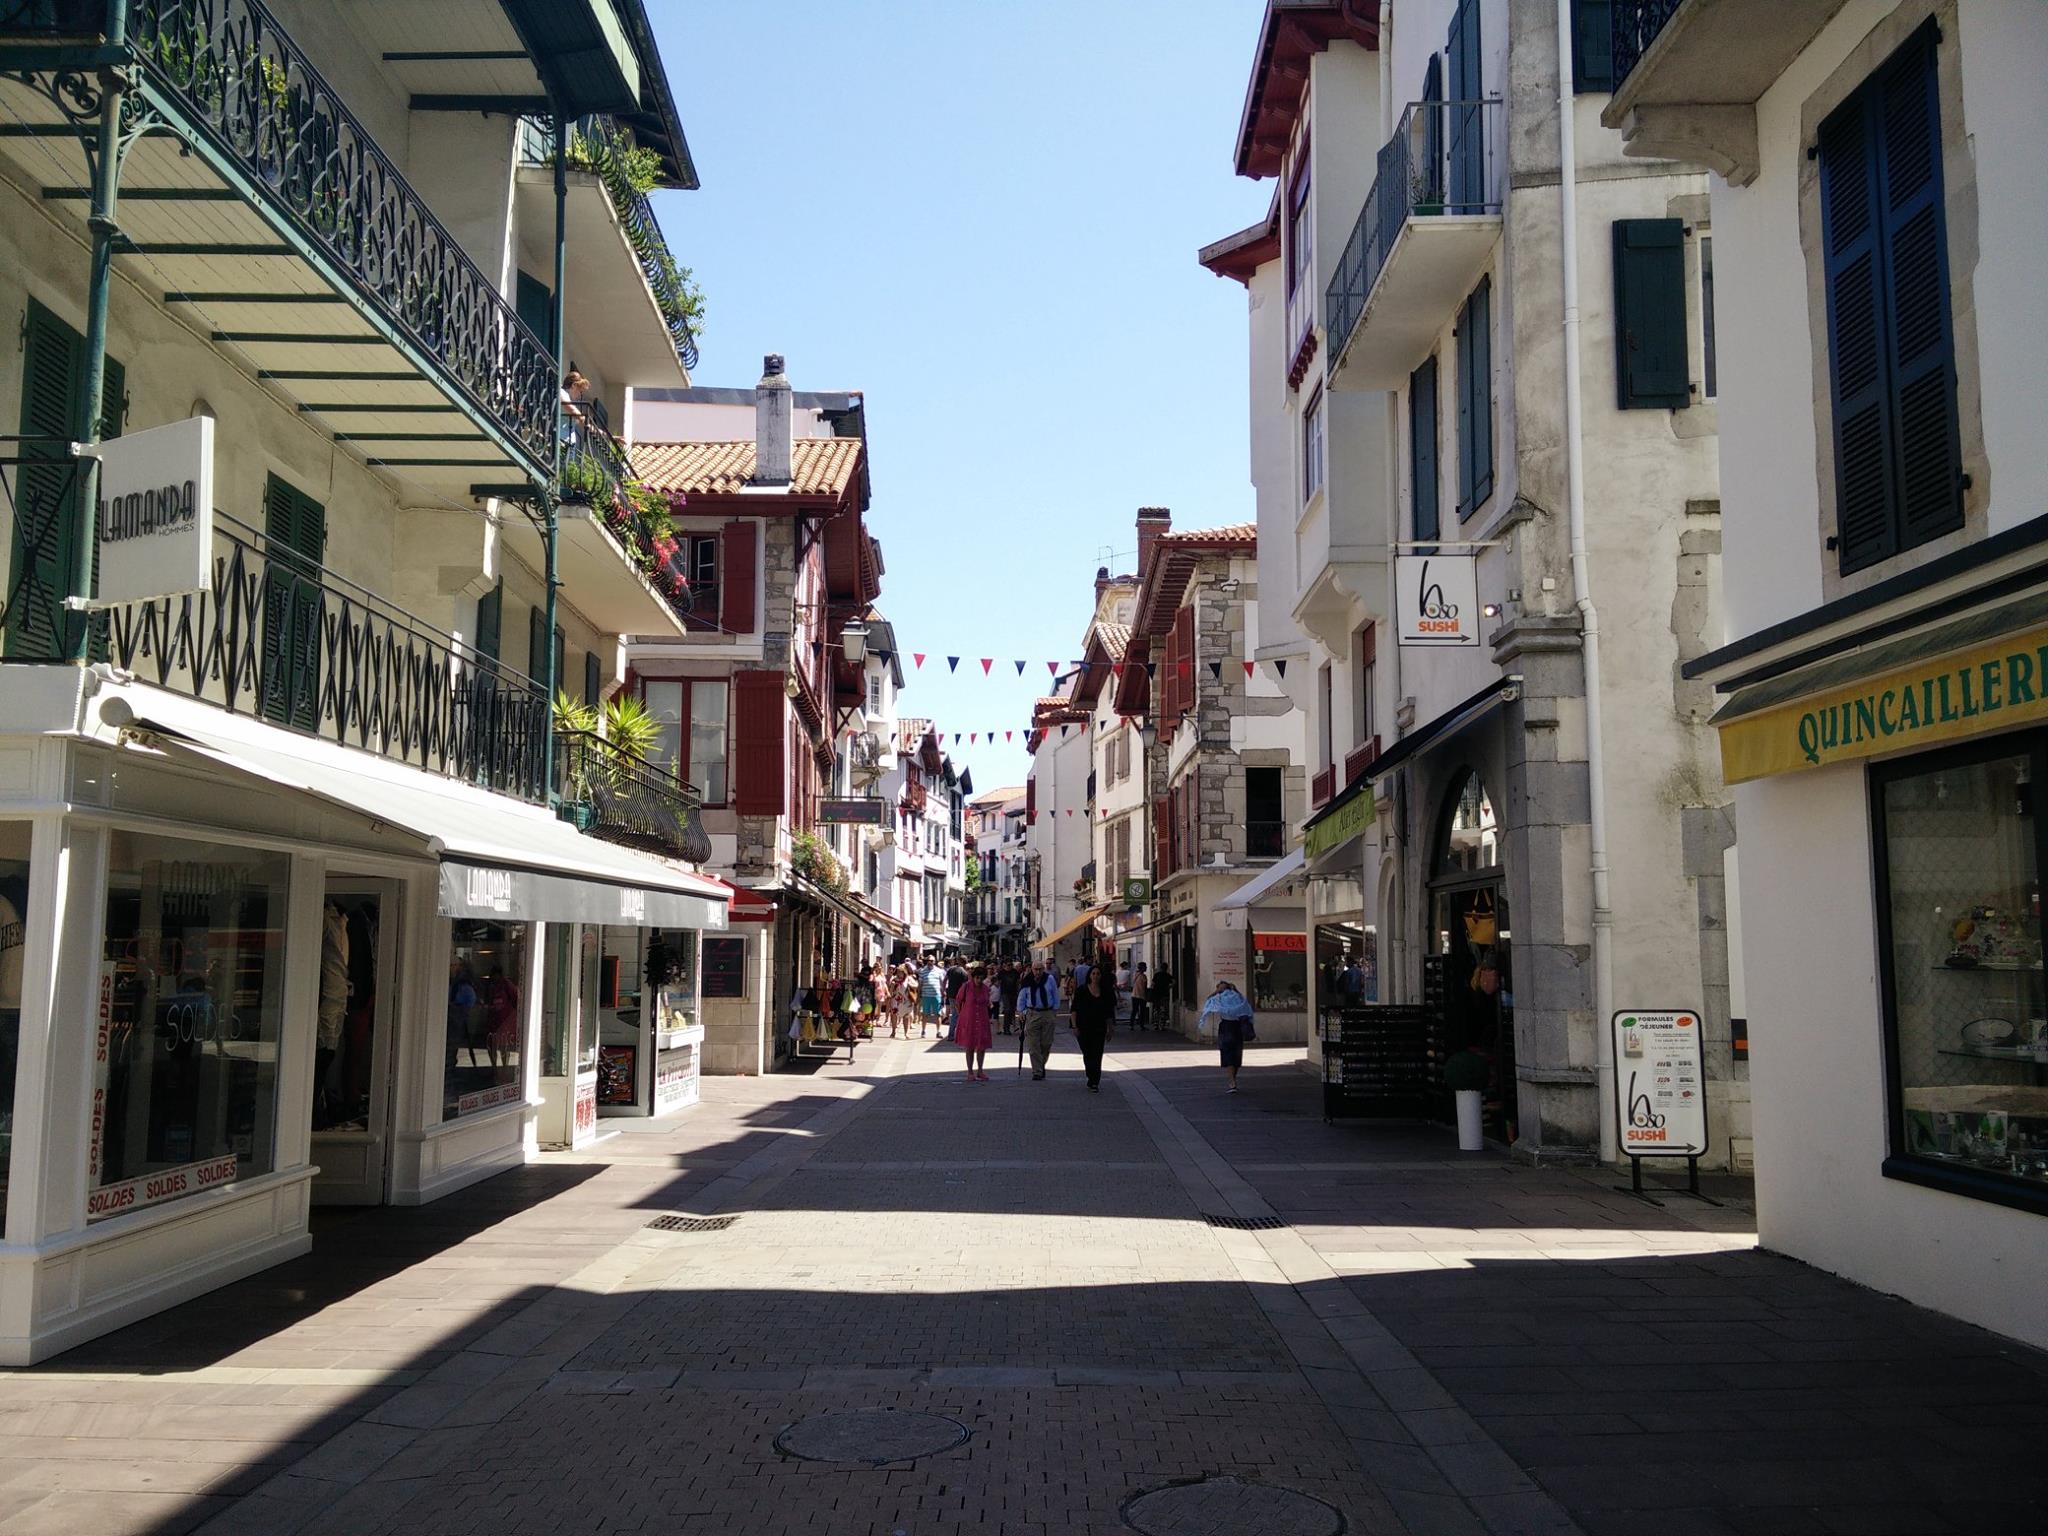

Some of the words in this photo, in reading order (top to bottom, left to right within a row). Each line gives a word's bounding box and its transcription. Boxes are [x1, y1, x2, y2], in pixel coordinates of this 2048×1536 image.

[101, 480, 196, 542] LAMANDA
[158, 523, 195, 537] HOMMES
[97, 974, 111, 1063] SOLDES
[89, 1087, 104, 1176] SOLDES
[88, 1187, 135, 1215] SOLDES
[146, 1174, 187, 1200] SOLDES
[197, 1161, 237, 1185] SOLDES
